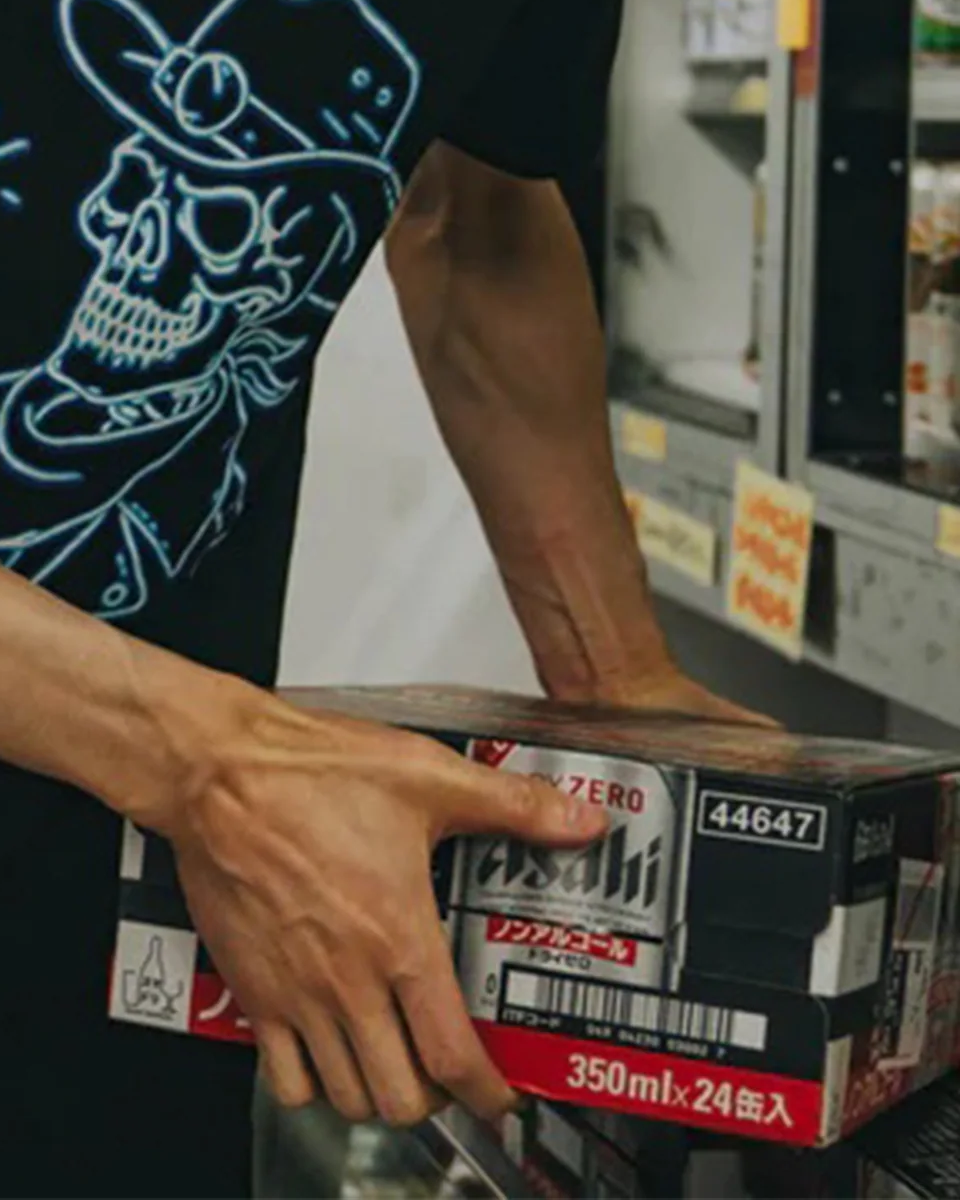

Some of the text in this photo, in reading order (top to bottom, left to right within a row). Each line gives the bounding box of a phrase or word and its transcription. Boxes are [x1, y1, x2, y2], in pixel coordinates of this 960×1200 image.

[569, 775, 647, 814] ZERO
[709, 801, 815, 839] 44647
[494, 919, 629, 961] ノンアルコール
